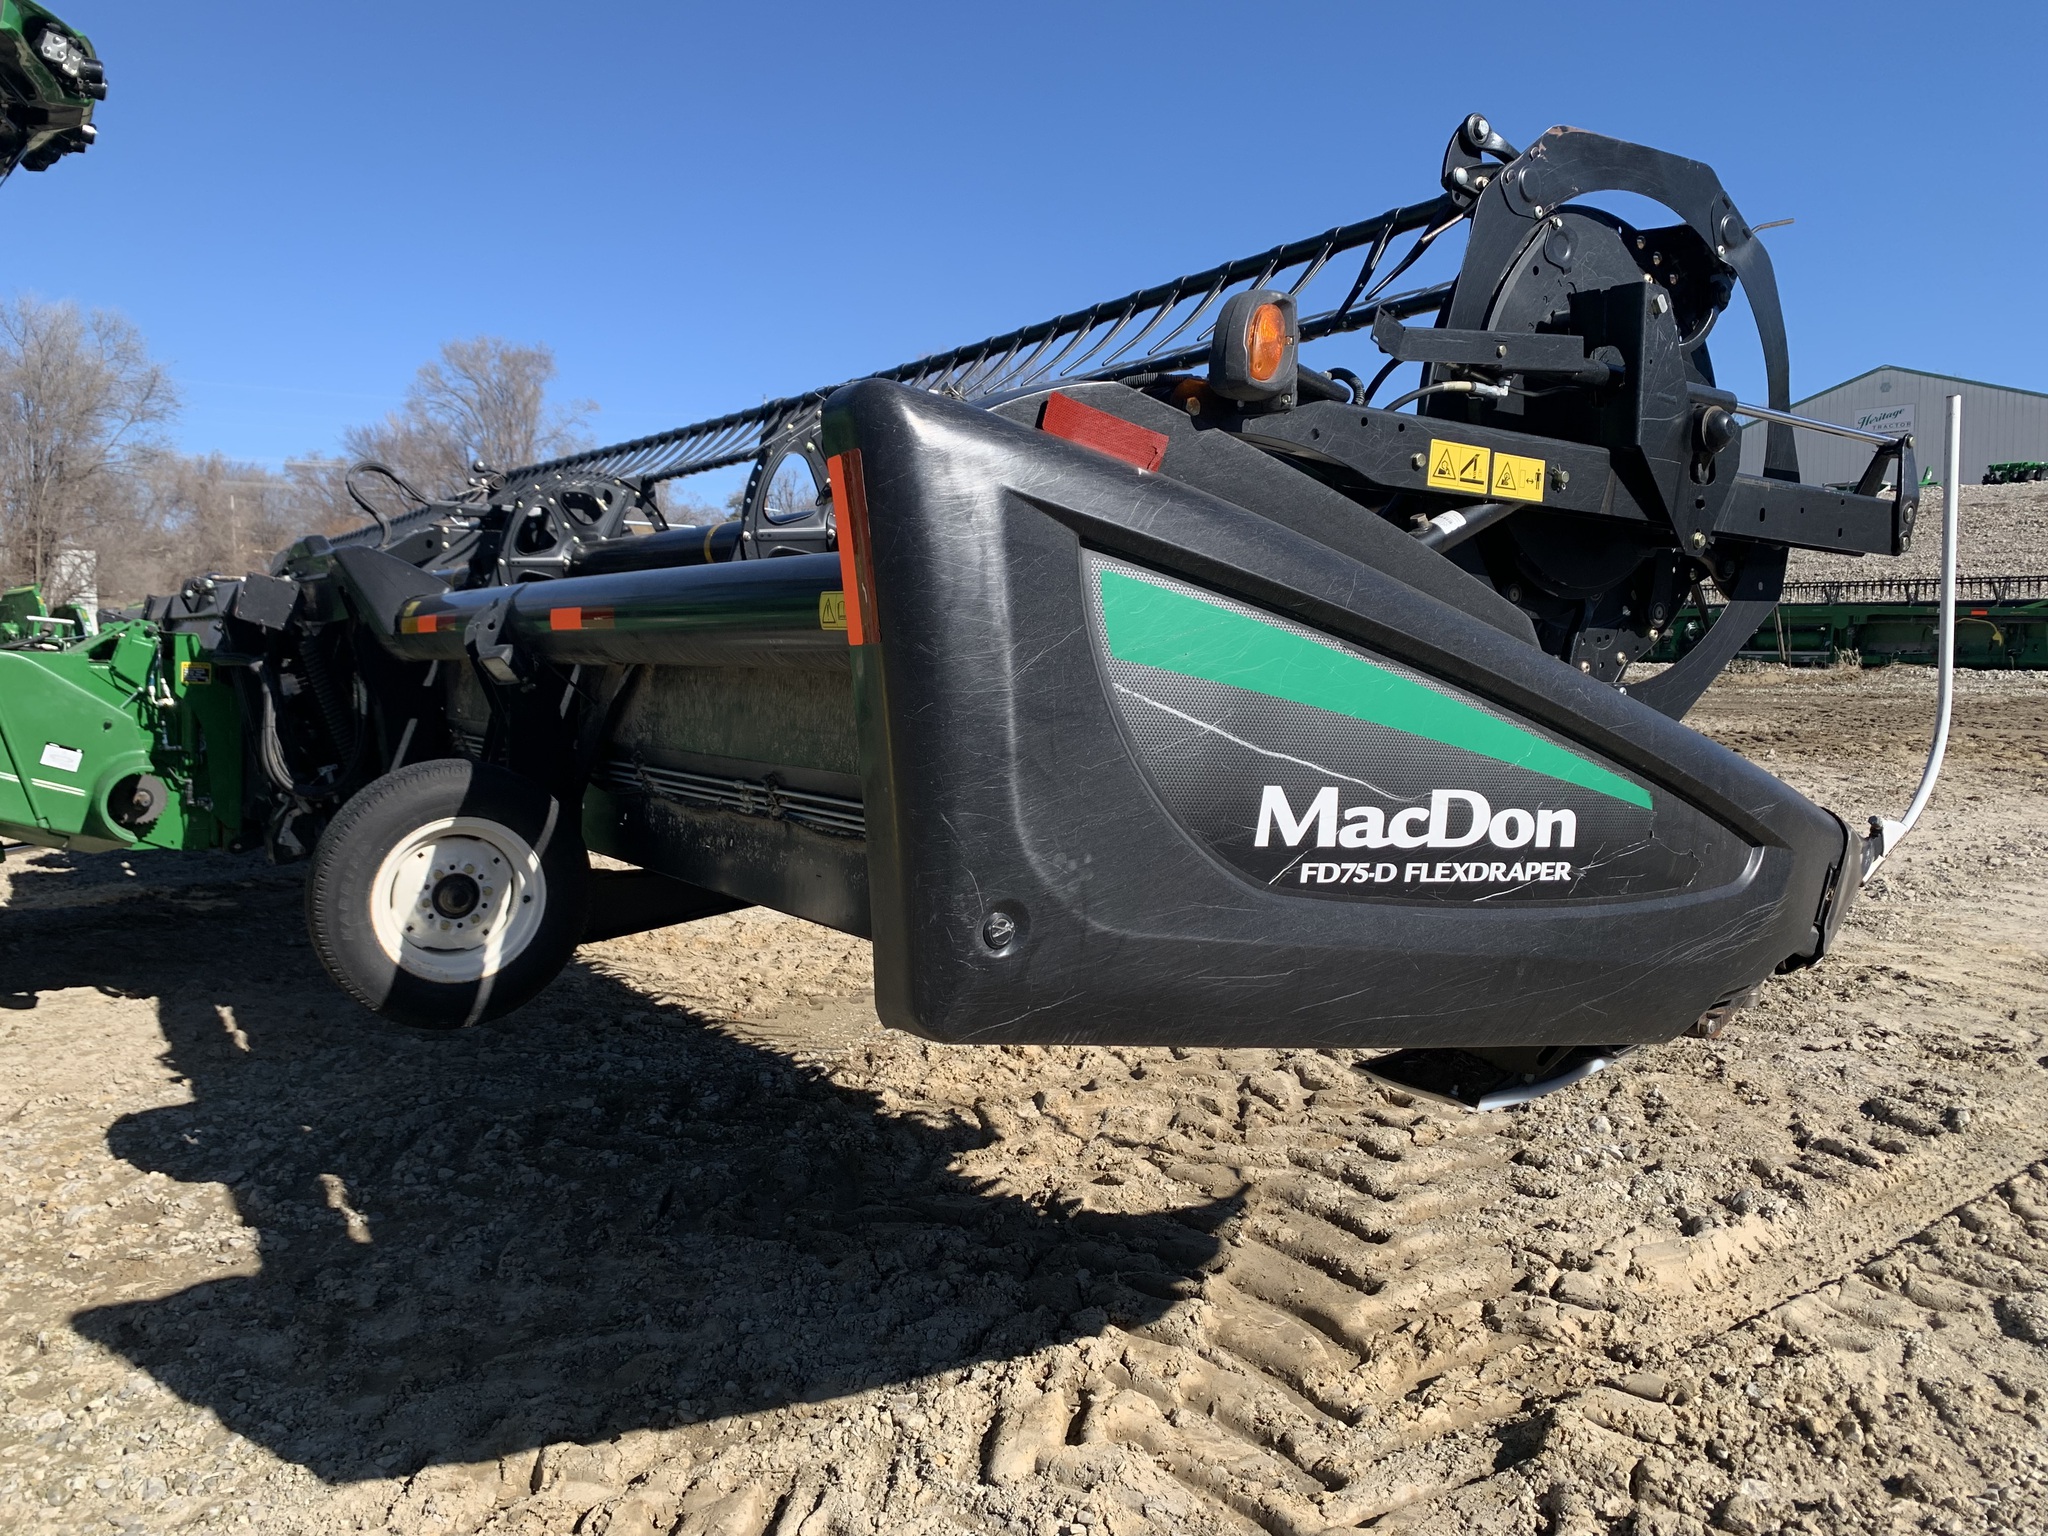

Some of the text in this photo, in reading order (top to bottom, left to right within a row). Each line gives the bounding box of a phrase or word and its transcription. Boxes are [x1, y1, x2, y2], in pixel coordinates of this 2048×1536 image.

[1857, 408, 1905, 429] Heritage
[1872, 421, 1912, 430] TRACTOR
[1254, 785, 1577, 849] MacDon
[1300, 861, 1572, 884] FD75-D FLEXDRAPER
